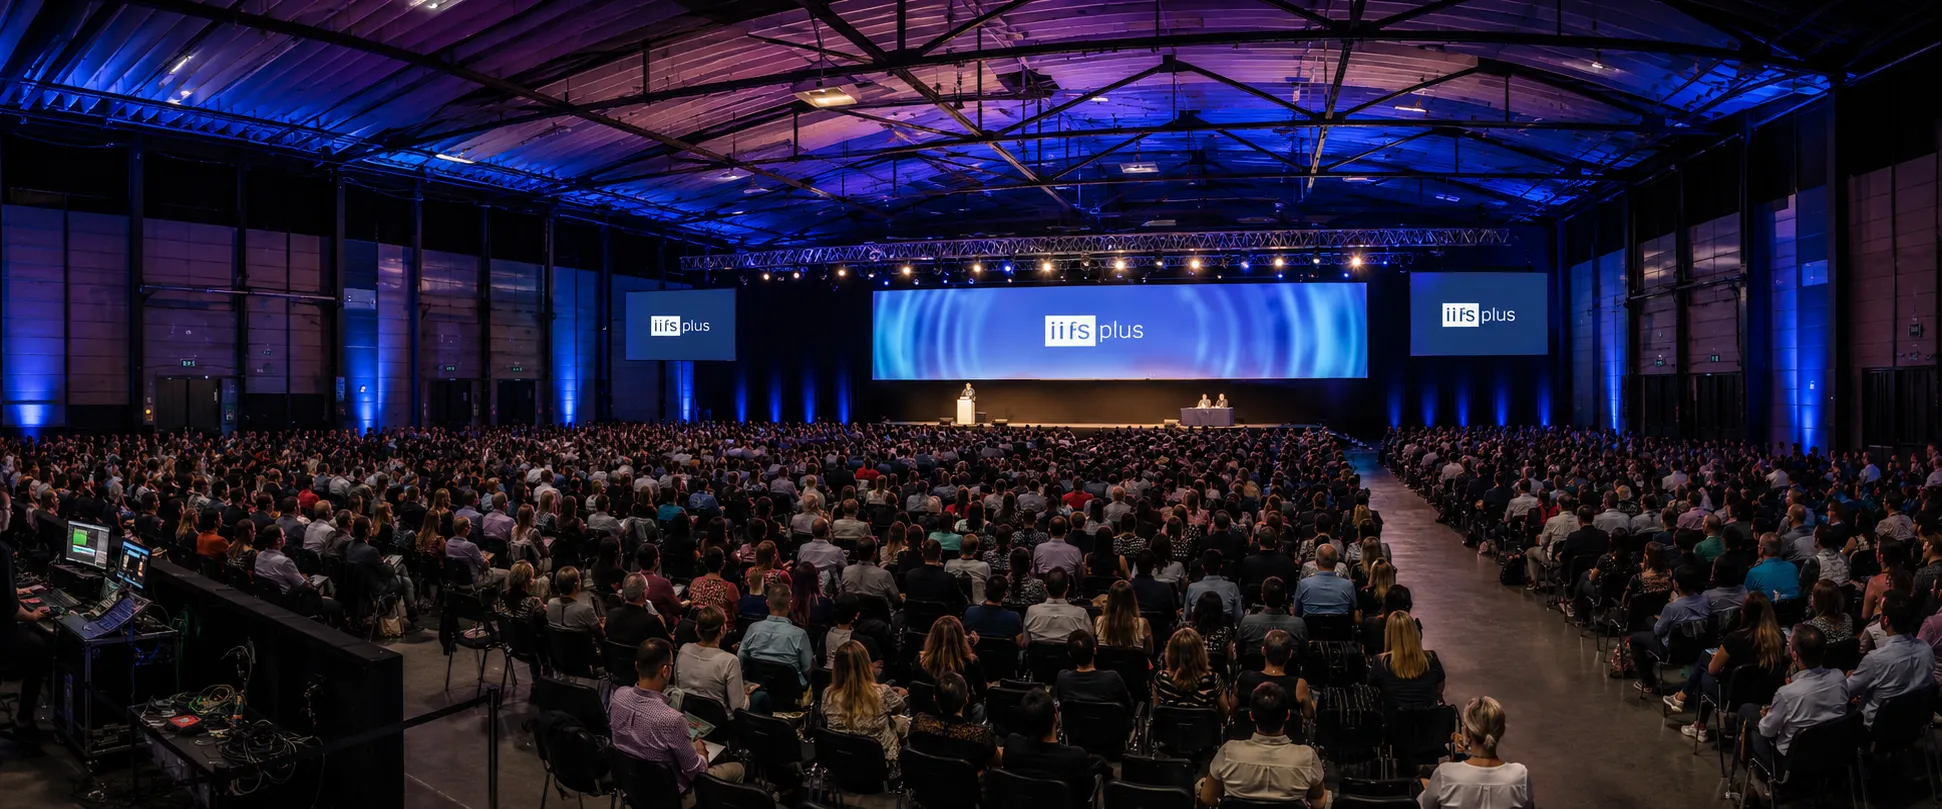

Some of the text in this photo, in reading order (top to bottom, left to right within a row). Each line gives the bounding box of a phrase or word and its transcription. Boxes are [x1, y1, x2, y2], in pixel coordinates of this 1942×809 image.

[1481, 307, 1516, 325] plus
[682, 319, 710, 334] plus
[1099, 320, 1144, 343] plus
